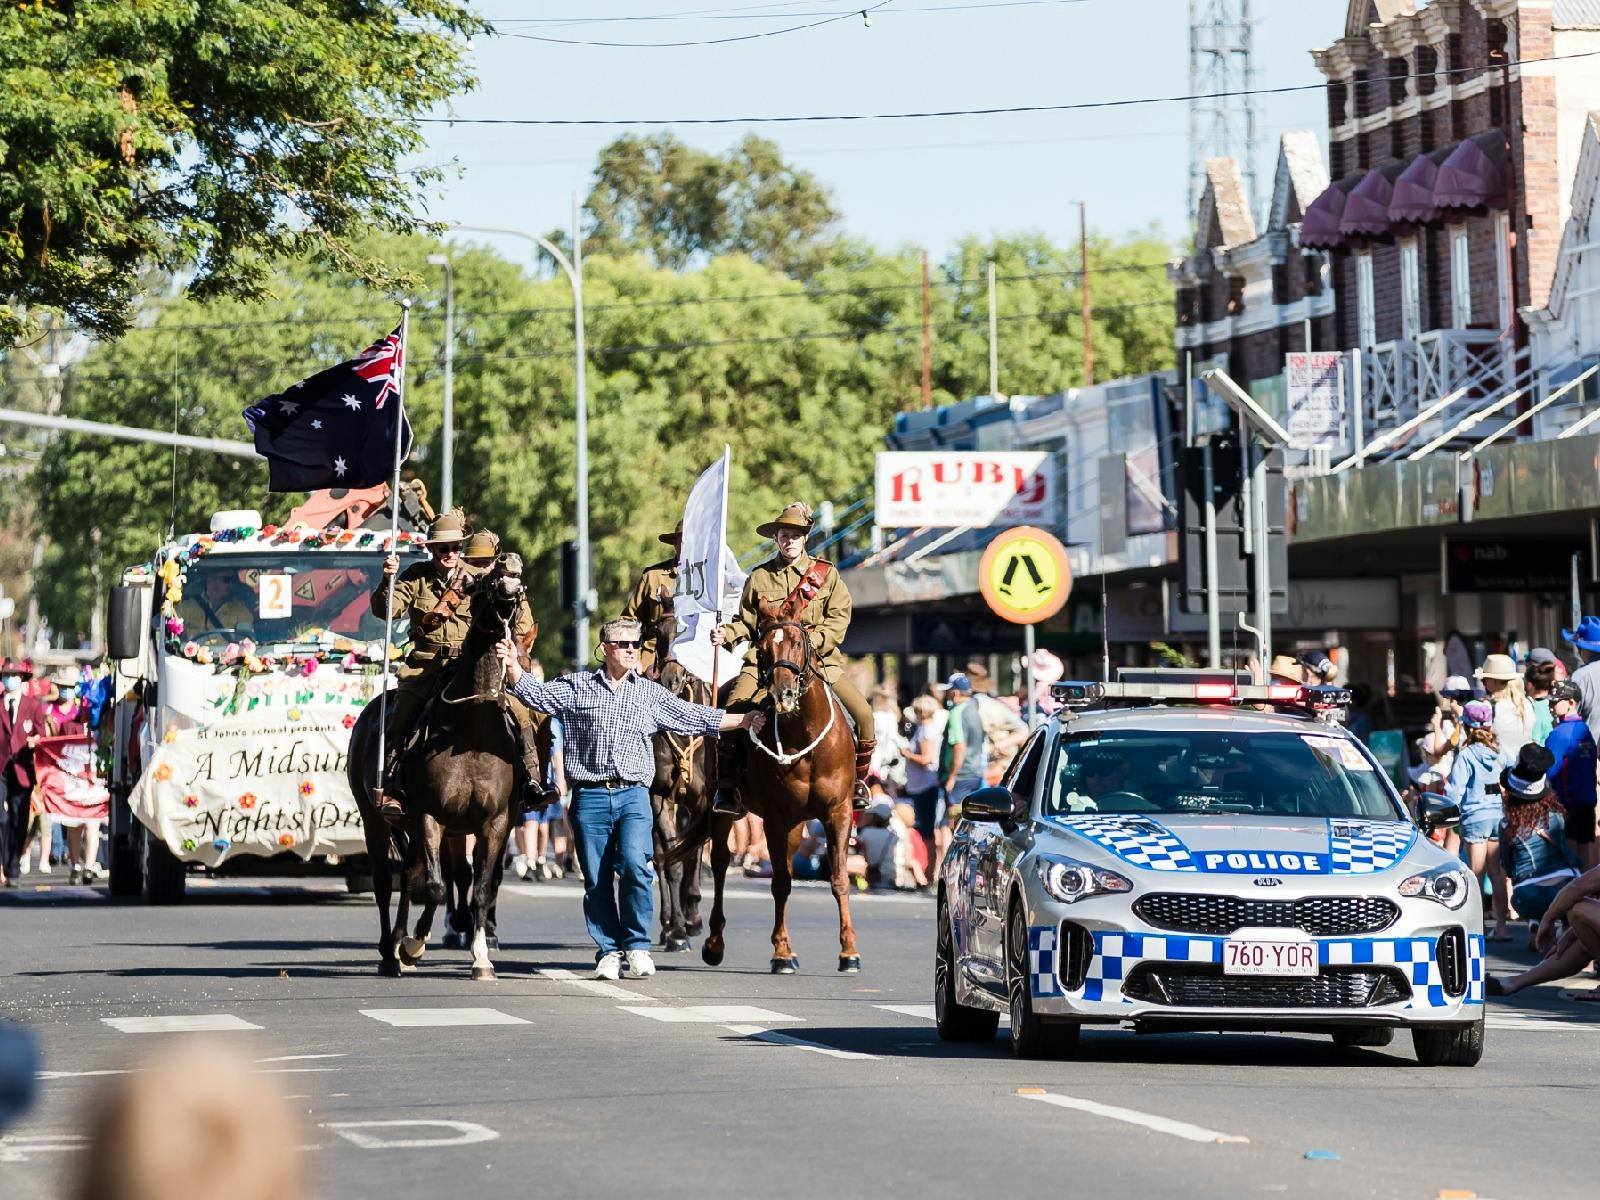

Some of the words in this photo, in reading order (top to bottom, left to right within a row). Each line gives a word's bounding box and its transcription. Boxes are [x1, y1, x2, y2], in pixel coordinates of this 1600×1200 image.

[1474, 545, 1507, 560] nab
[268, 577, 285, 610] 2
[186, 752, 213, 786] A
[195, 801, 304, 844] Nights
[1205, 853, 1321, 871] POLICE
